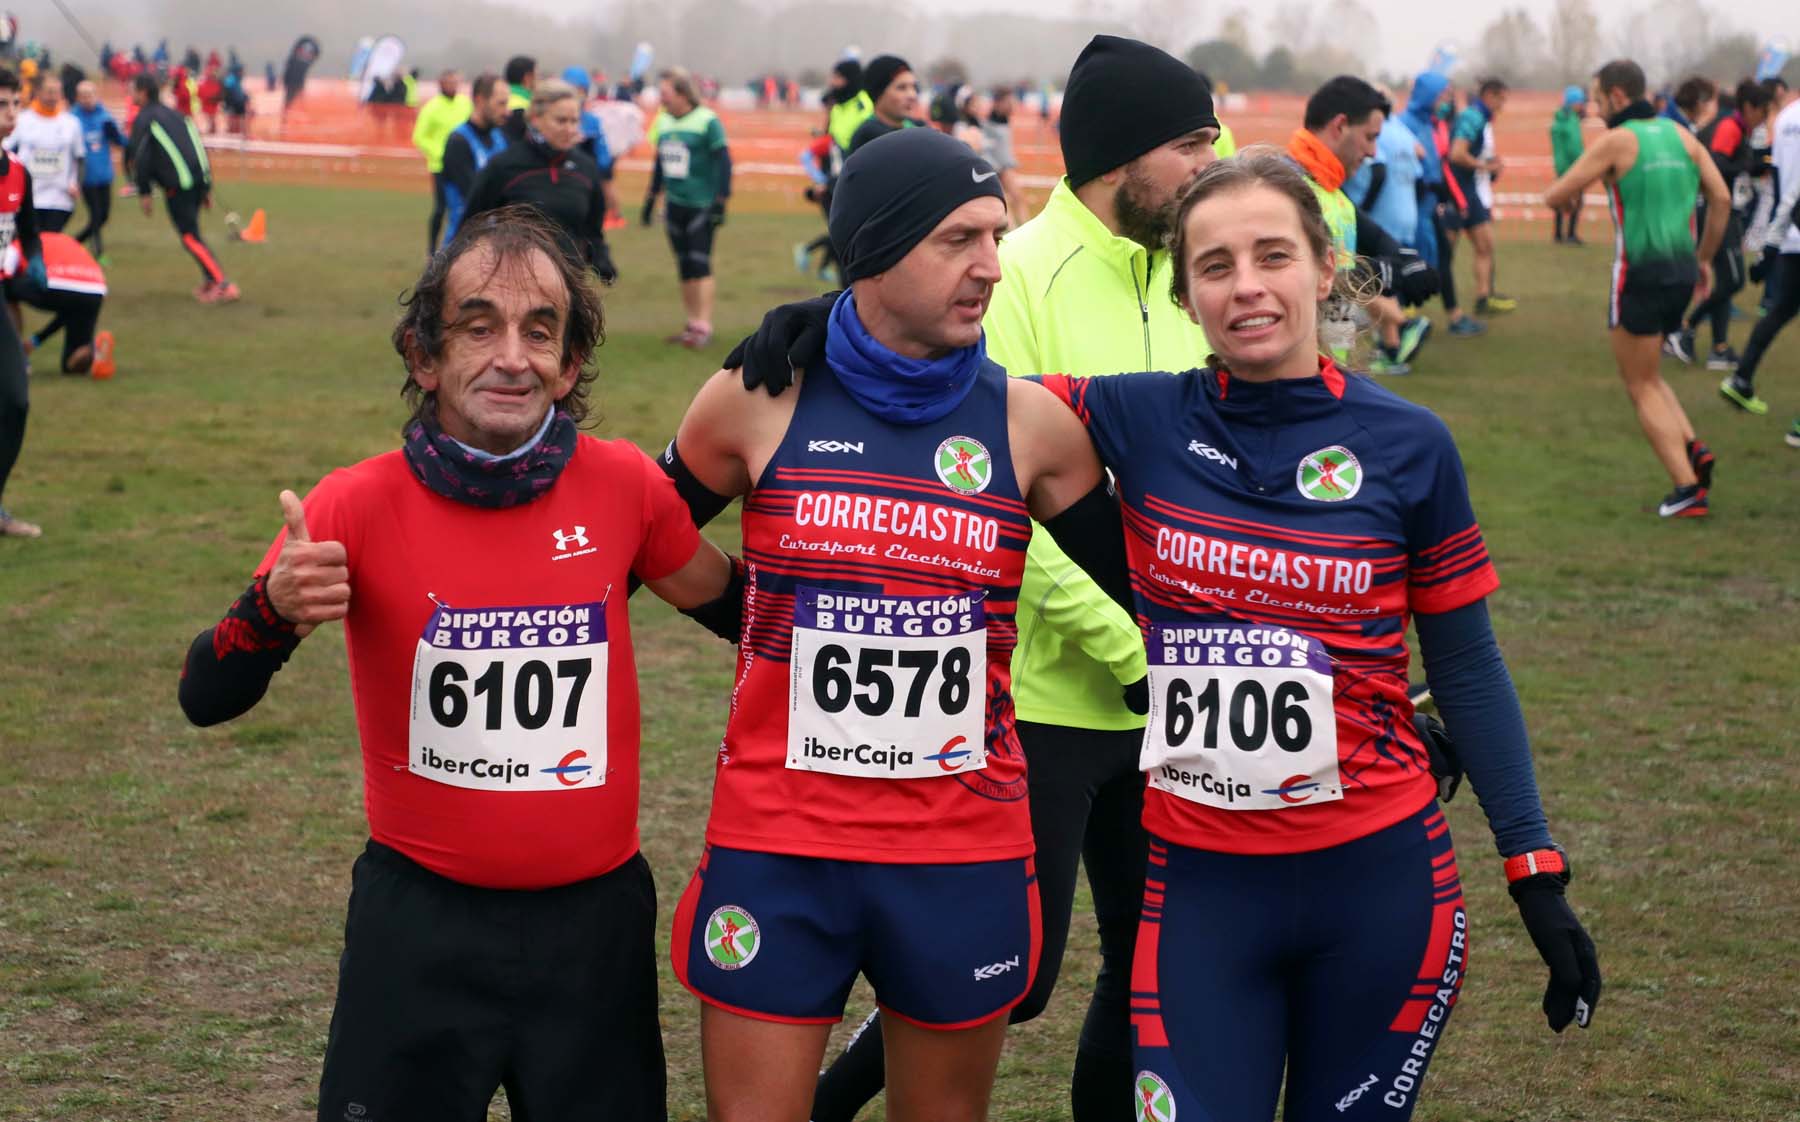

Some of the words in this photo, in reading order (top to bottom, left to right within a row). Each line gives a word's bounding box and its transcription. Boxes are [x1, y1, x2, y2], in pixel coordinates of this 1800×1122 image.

[808, 440, 864, 454] KON
[795, 493, 999, 552] CORRECASTRO
[779, 534, 876, 556] Eurosport
[884, 544, 1001, 578] Electrónicos
[1156, 527, 1372, 595] CORRECASTRO
[438, 606, 590, 628] DIPUTACIÓN
[816, 594, 971, 616] DIPUTACIÓN
[1245, 589, 1380, 616] Electrónicos
[432, 626, 590, 649] BURGOS
[816, 611, 972, 636] BURGOS
[1163, 628, 1309, 651] DIPUTACIÓN
[1164, 646, 1309, 667] BURGOS
[429, 658, 592, 730] 6107
[812, 644, 971, 717] 6578
[1165, 678, 1312, 752] 6106
[421, 747, 529, 783] iberCaja
[804, 737, 913, 771] iberCaja
[1161, 765, 1251, 802] iberCaja
[1383, 911, 1467, 1109] CORRECASTRO
